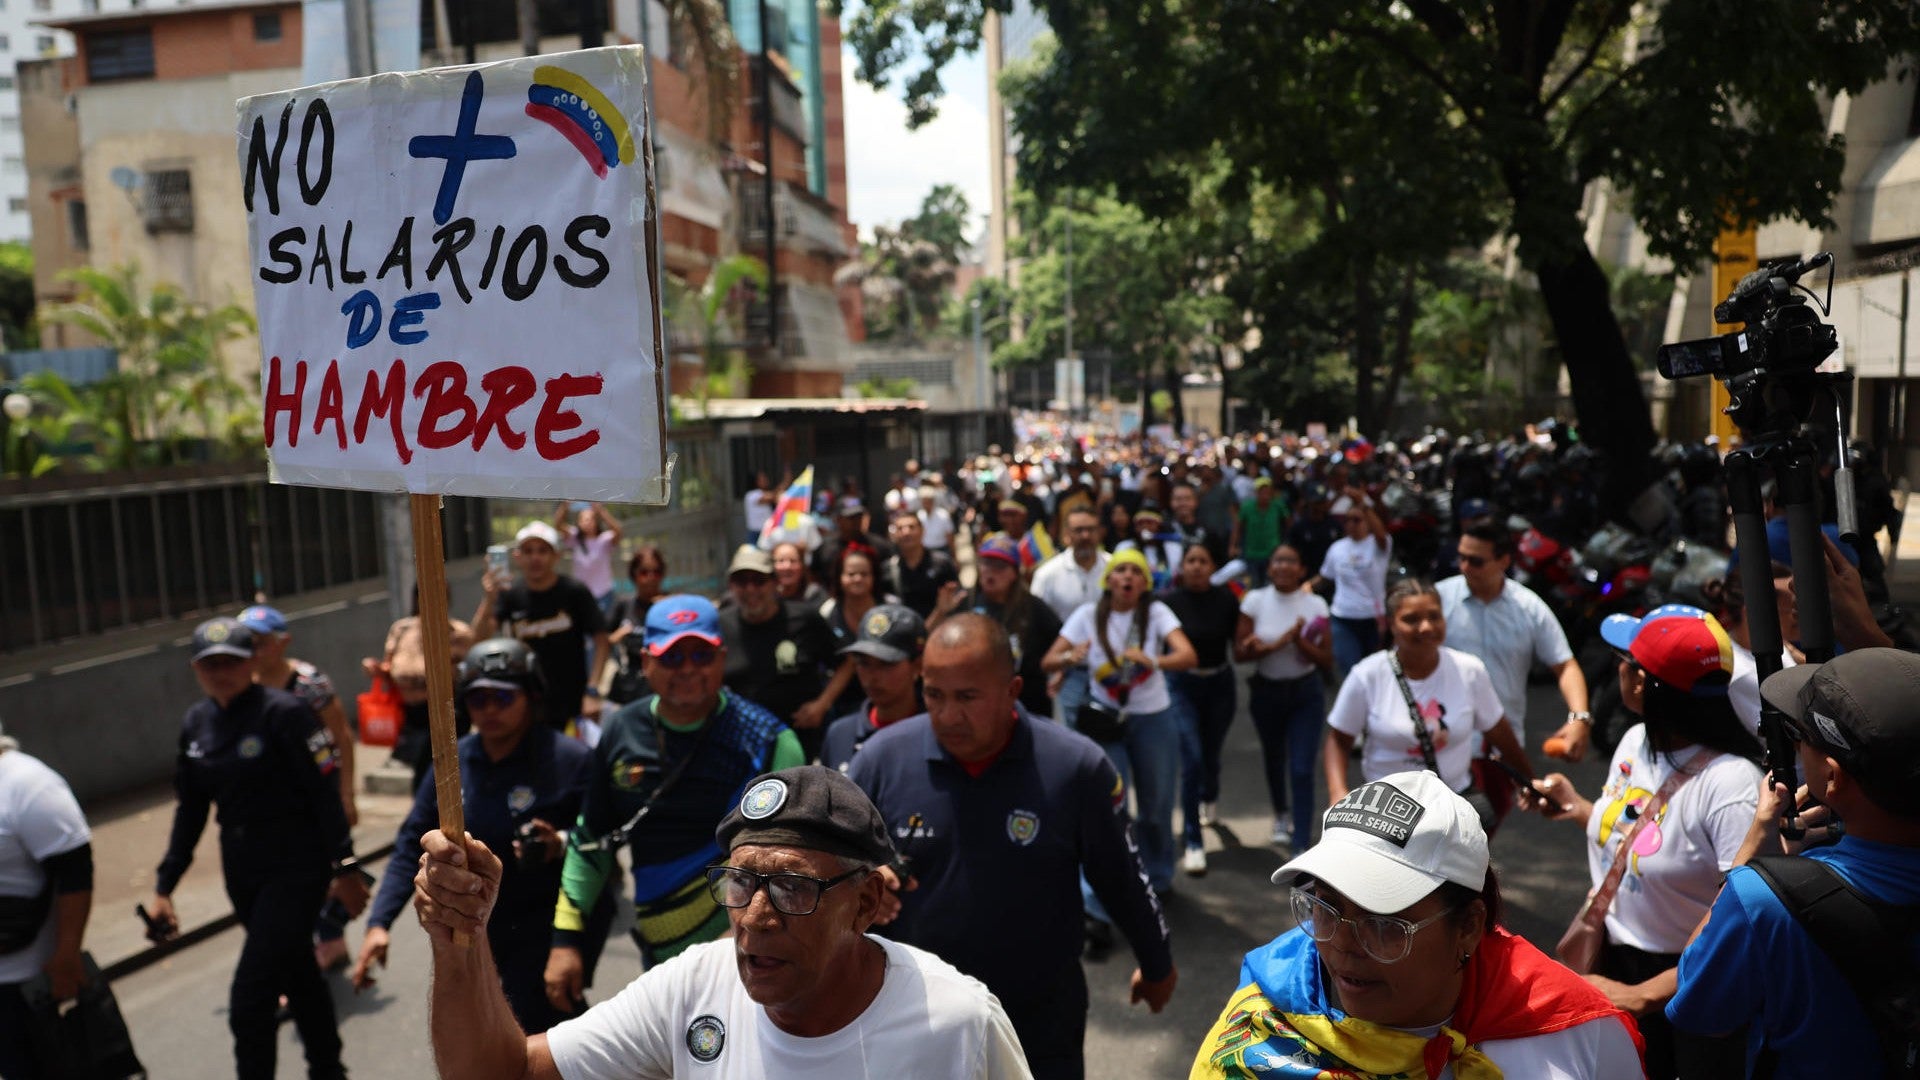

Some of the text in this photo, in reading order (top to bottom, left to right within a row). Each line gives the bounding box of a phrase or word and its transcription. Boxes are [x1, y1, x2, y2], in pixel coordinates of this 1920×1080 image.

[244, 98, 334, 215] NO
[260, 215, 610, 305] SALARIOS
[341, 290, 441, 349] DE
[264, 357, 603, 464] HAMBRE
[1326, 812, 1408, 841] TACTICAL SERIES
